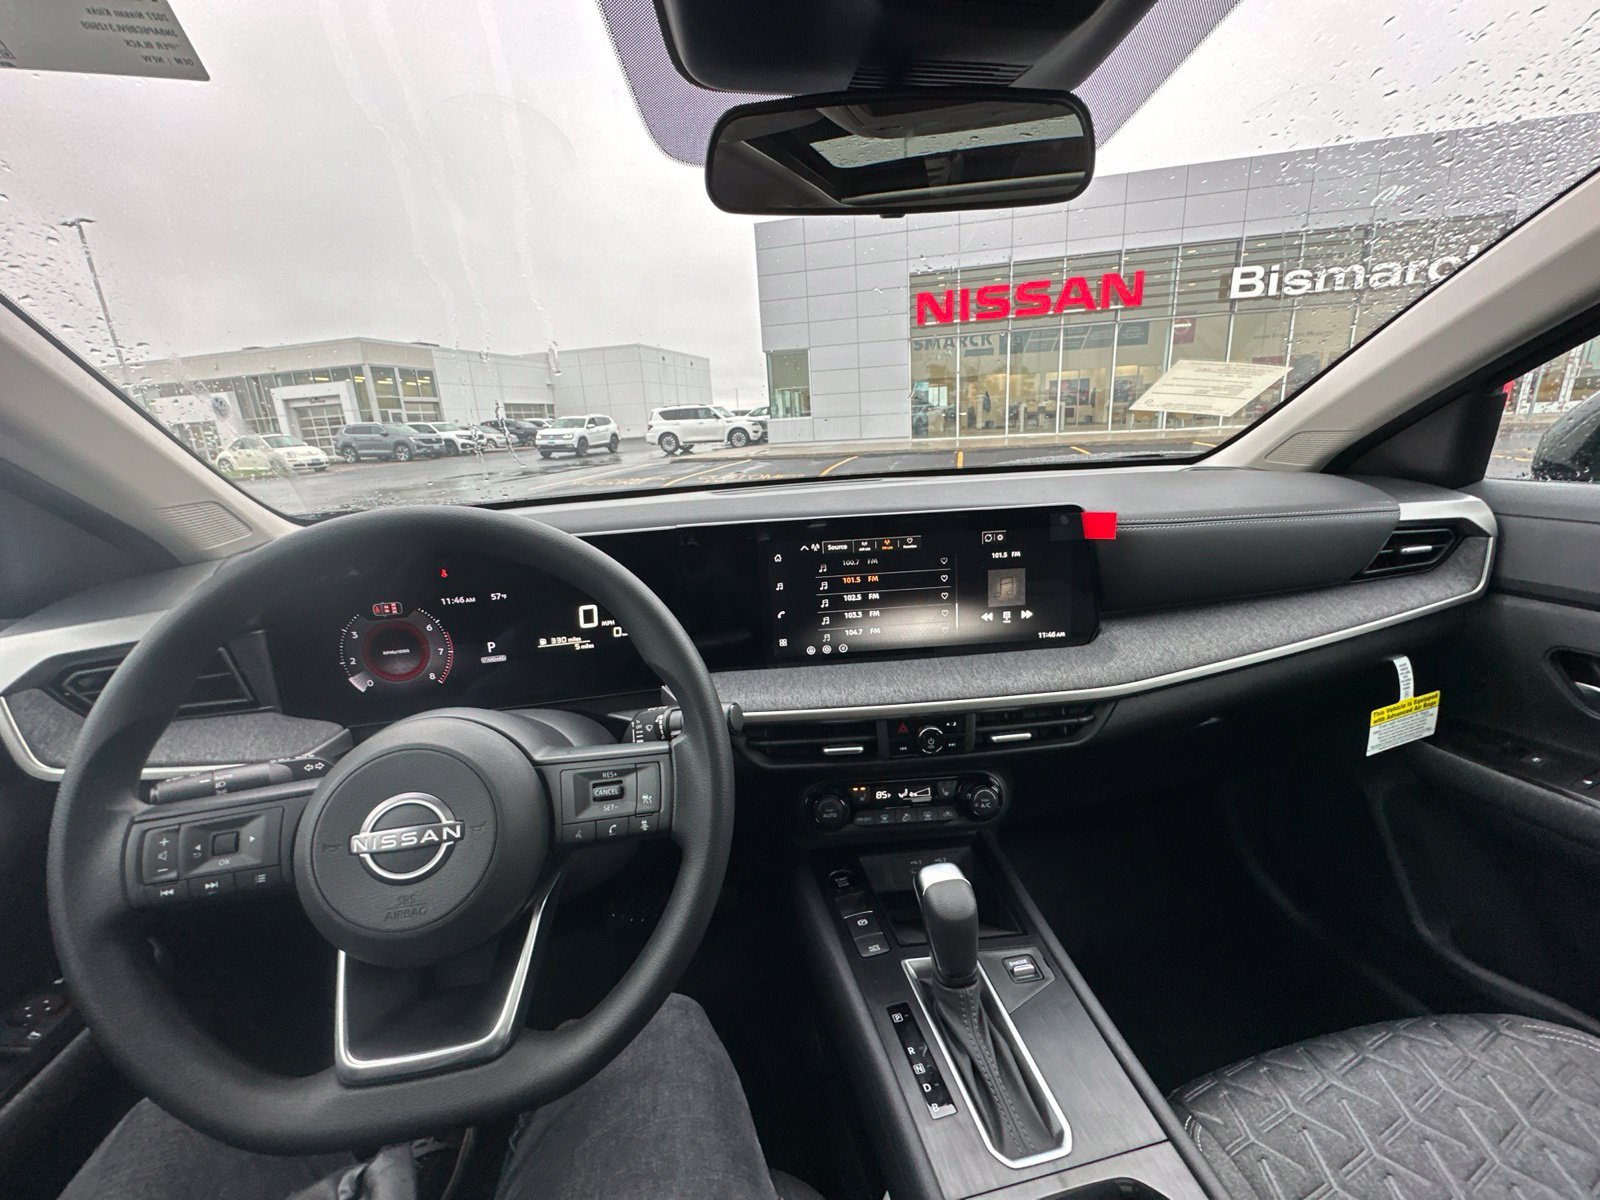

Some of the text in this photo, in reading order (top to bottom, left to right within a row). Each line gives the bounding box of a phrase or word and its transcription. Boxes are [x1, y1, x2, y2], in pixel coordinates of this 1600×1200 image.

[1229, 246, 1478, 300] Bismarc
[916, 270, 1146, 327] NISSAN
[827, 543, 848, 551] Source
[991, 550, 1021, 559] 101.5 FM
[867, 557, 878, 565] FM
[842, 575, 879, 584] 101.5 FM
[441, 596, 465, 606] 11:46
[490, 592, 508, 601] 57°F
[843, 592, 880, 602] 102.5 FM
[578, 604, 599, 629] 0
[844, 610, 880, 619] 103.3 FM
[601, 619, 615, 627] MPH
[426, 624, 434, 632] 6
[613, 626, 622, 637] 0
[845, 627, 881, 636] 104.7 FM
[351, 630, 359, 639] 3
[550, 636, 567, 645] 330
[437, 647, 445, 656] 7
[486, 641, 496, 653] P
[349, 657, 357, 665] 2
[428, 672, 436, 680] 8
[366, 679, 375, 687] 0
[1373, 710, 1385, 718] This
[1386, 703, 1406, 714] Vehicle
[1413, 692, 1439, 705] Equipped
[1373, 716, 1386, 724] with
[1386, 708, 1413, 720] Advanced
[1423, 699, 1437, 709] Bags
[593, 788, 619, 797] CANCEL
[353, 824, 462, 853] NISSAN
[218, 858, 231, 867] OK
[384, 907, 428, 922] AIRBAG
[907, 1046, 916, 1055] R
[922, 1083, 932, 1093] D
[931, 1103, 940, 1113] B
